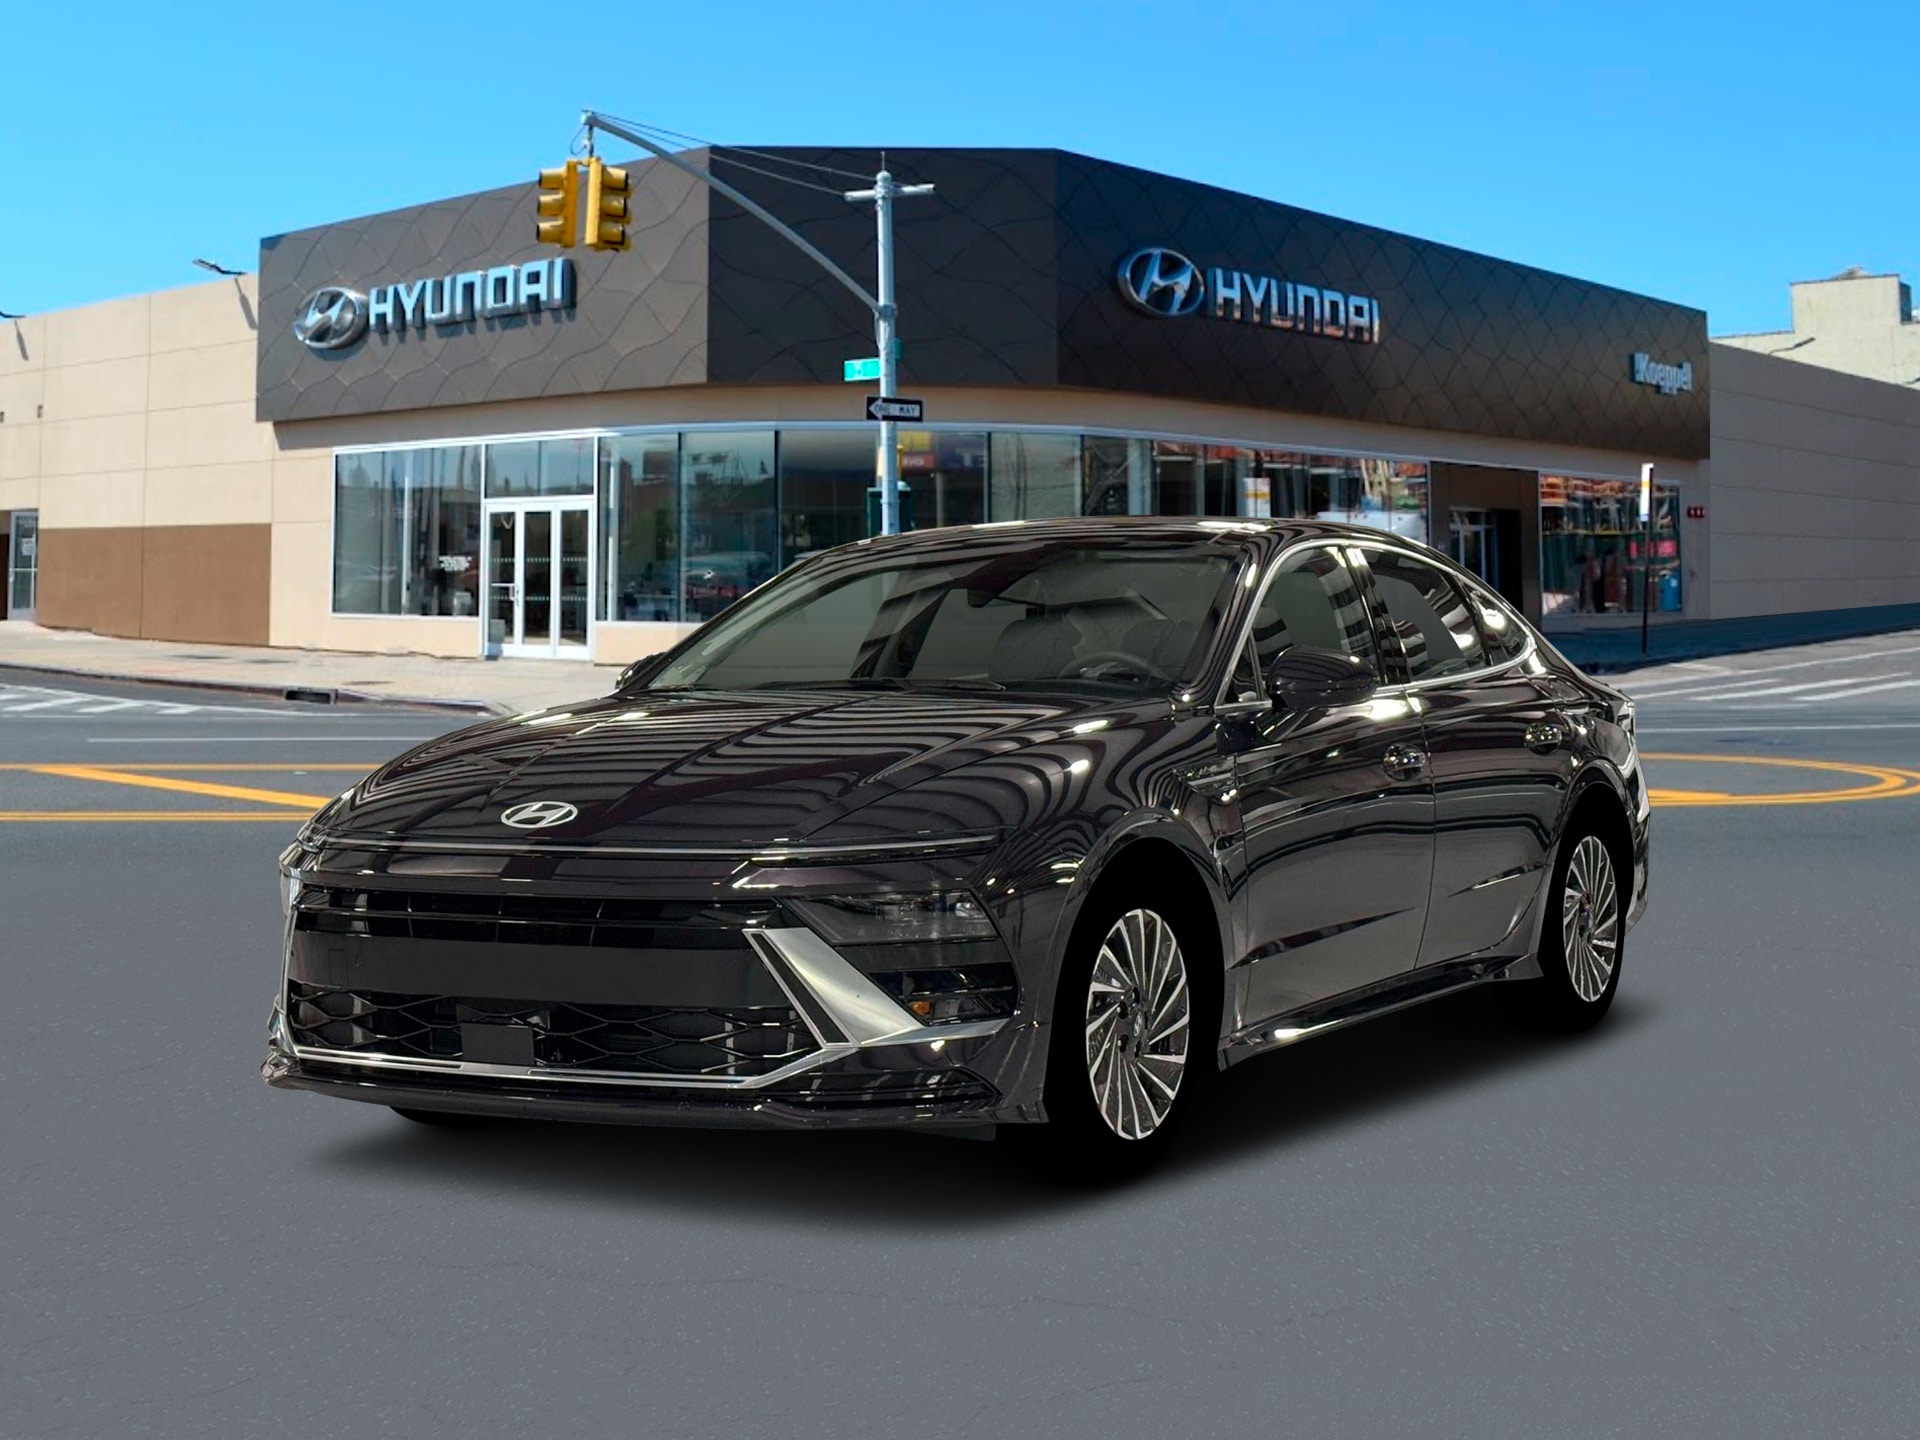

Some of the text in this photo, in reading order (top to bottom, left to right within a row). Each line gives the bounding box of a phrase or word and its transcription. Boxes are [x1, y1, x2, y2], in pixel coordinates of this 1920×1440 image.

[368, 257, 575, 330] HYUNDAI
[1213, 267, 1380, 343] HYUNDAI
[874, 403, 916, 415] ONE WAY
